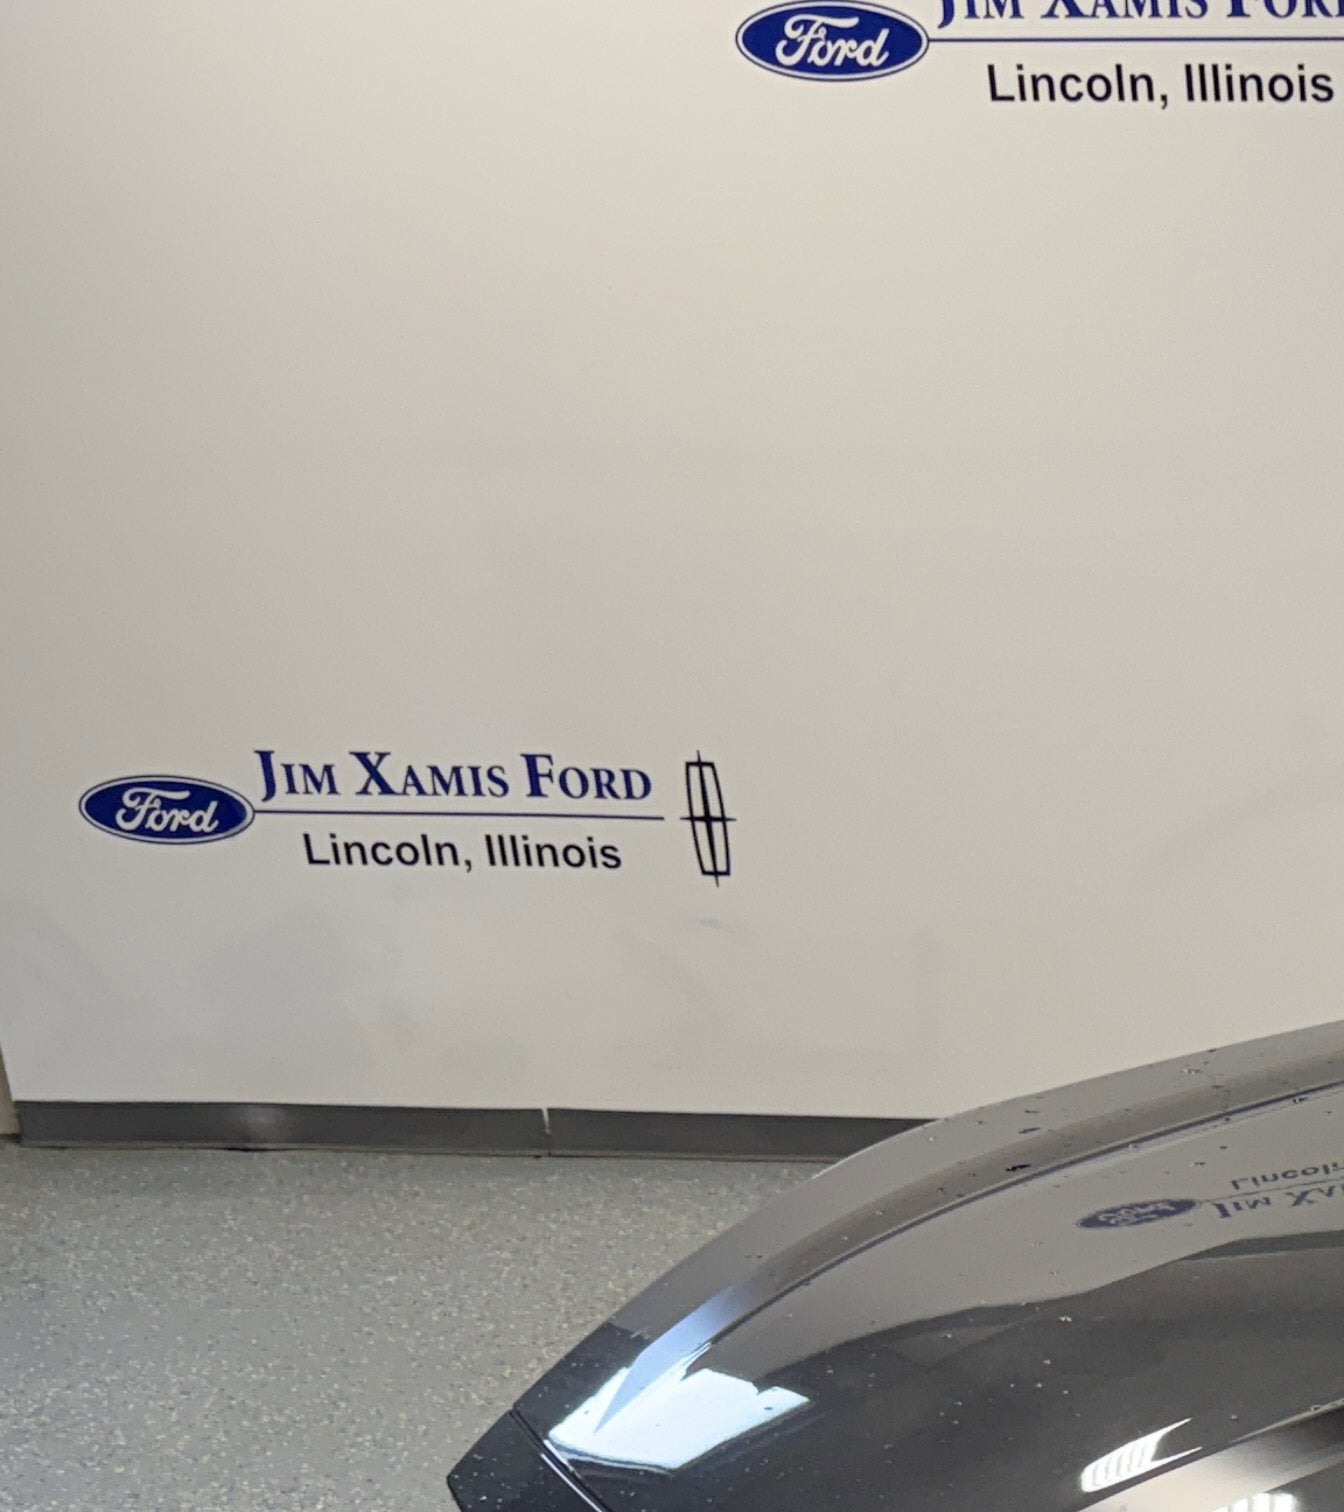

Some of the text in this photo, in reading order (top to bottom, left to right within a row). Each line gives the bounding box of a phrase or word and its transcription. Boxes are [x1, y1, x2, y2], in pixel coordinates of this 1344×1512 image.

[987, 63, 1334, 110] Lincoln, Illinois
[253, 749, 652, 803] JIM XAMIS FORD
[302, 832, 622, 873] Lincoln, Illinois
